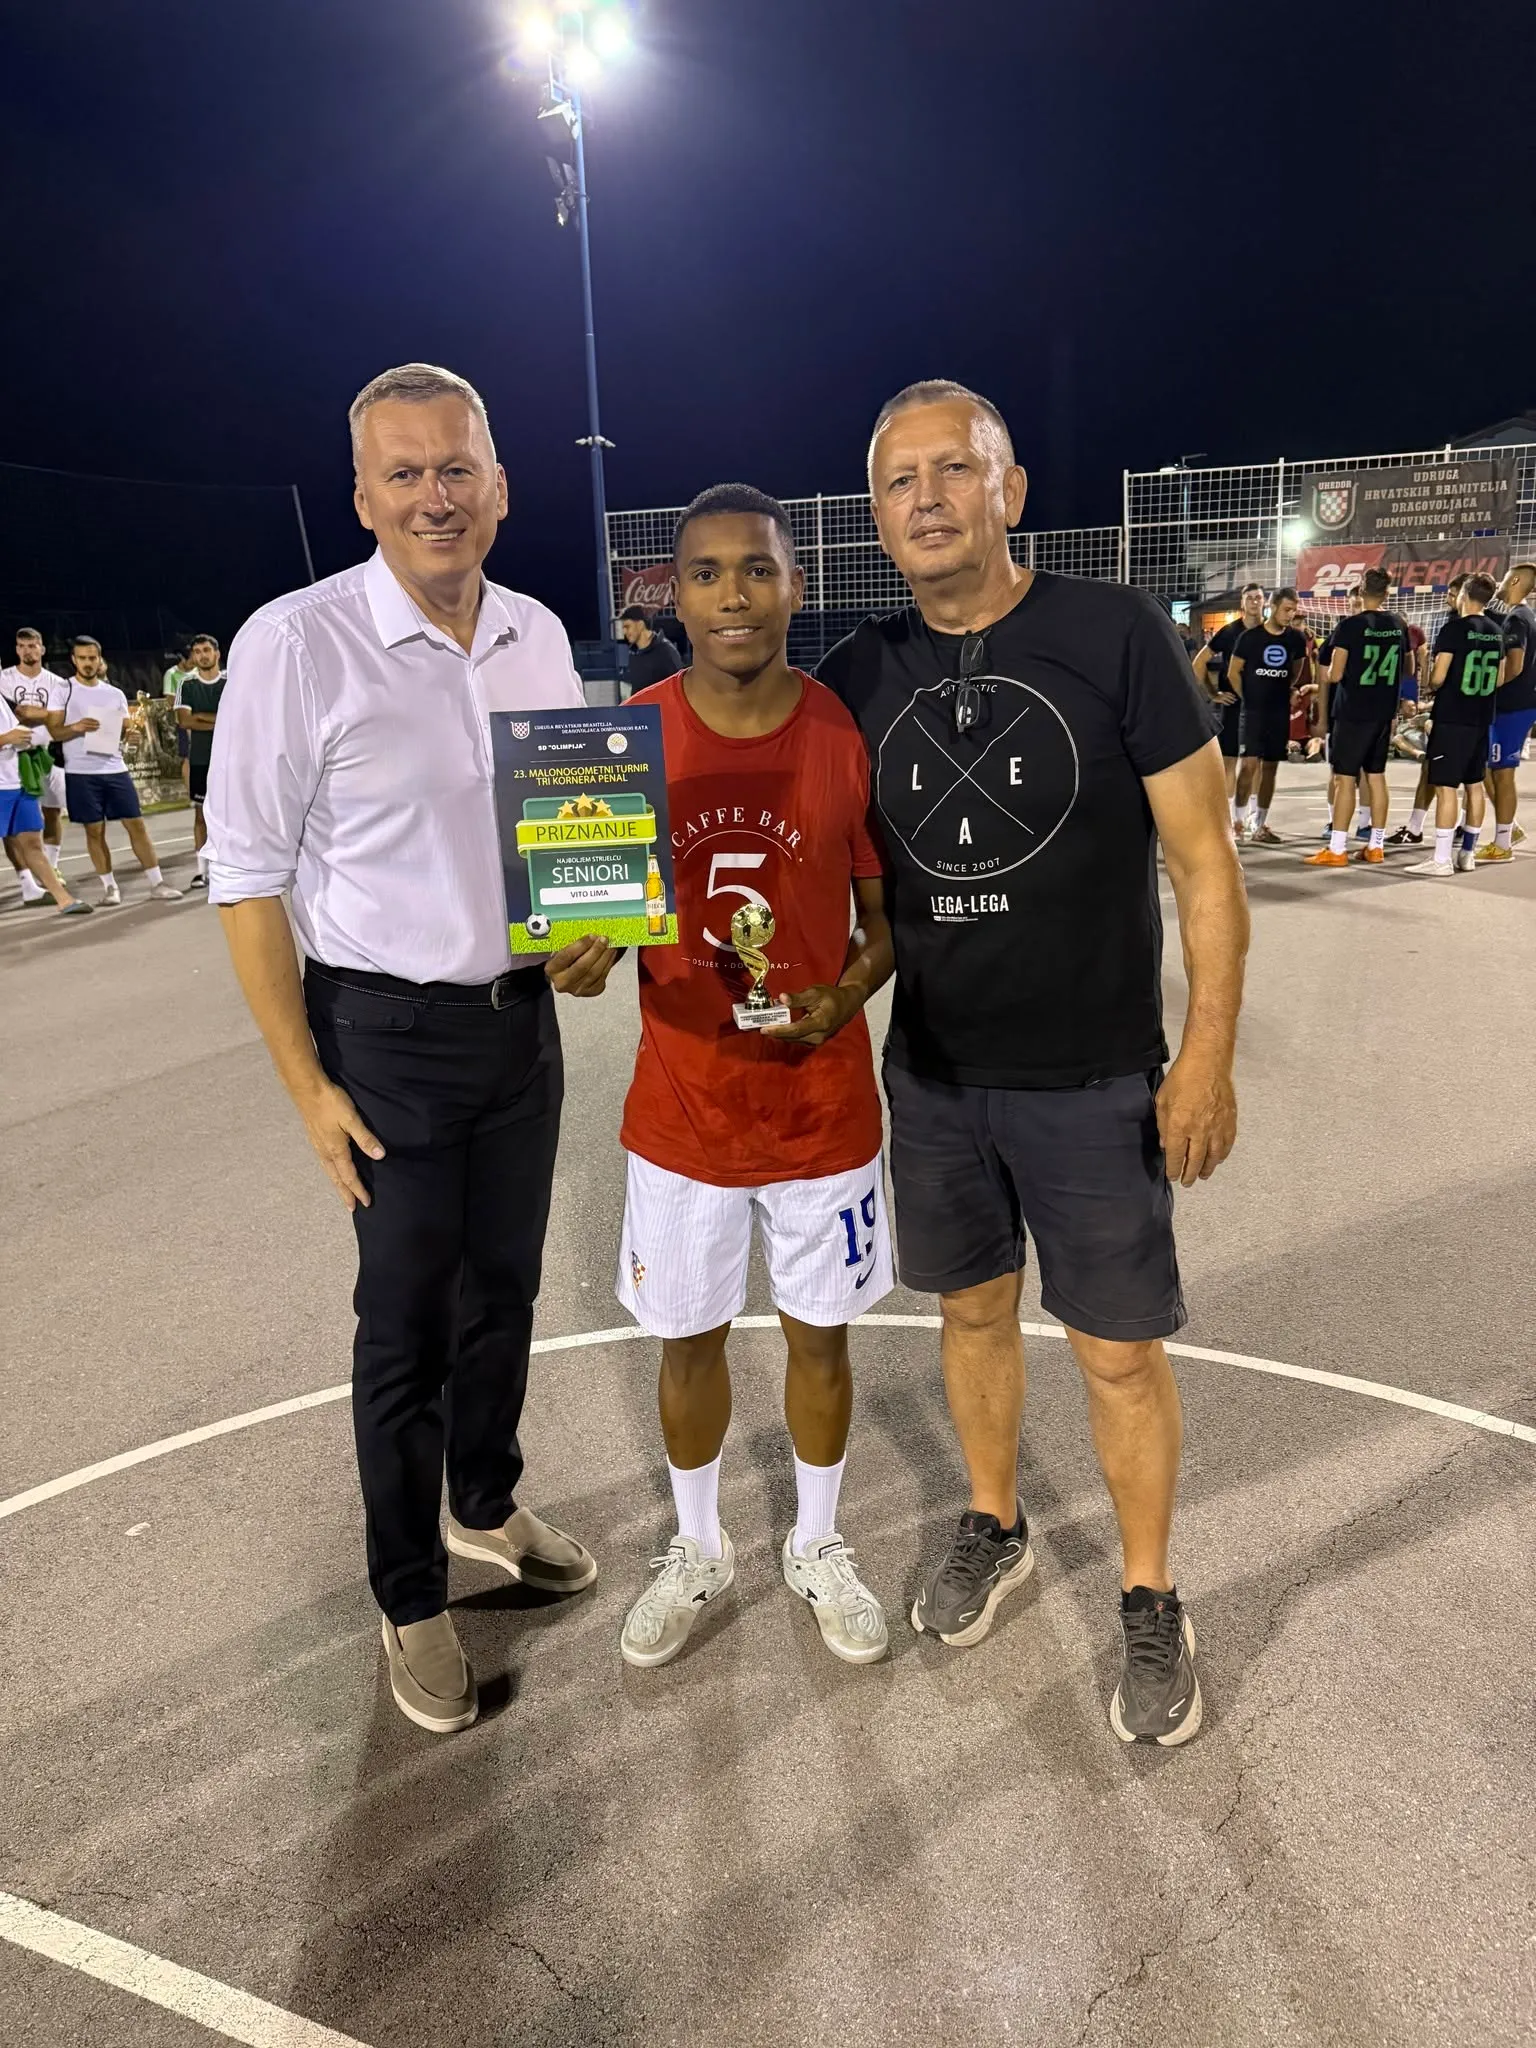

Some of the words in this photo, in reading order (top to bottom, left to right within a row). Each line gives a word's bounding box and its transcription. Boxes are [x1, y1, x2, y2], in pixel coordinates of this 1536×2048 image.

[1413, 469, 1459, 483] UDRUGA
[1364, 488, 1430, 500] HRVATSKIH
[1435, 480, 1508, 496] BRANITELJA
[1391, 498, 1478, 513] DRAGOVOLJACA
[1375, 515, 1455, 529] DOMOVINSKOG
[1459, 511, 1492, 523] RATA
[1310, 563, 1366, 592] 25
[1255, 668, 1288, 678] exoro
[1360, 644, 1400, 686] 24
[1461, 650, 1500, 697] 66
[940, 684, 998, 698] AUTTIC
[514, 769, 528, 779] 23.
[529, 765, 614, 778] MALONOGOMETNI
[616, 763, 649, 775] TURNIR
[536, 777, 551, 787] TRI
[553, 775, 597, 786] KORNERA
[599, 773, 628, 784] PENAL
[912, 764, 923, 791] L
[1009, 756, 1023, 786] E
[536, 821, 638, 842] PRIZNANJE
[671, 806, 745, 848] CAFFE
[758, 809, 801, 849] BAR
[958, 817, 973, 845] A
[551, 863, 629, 884] SENIORI
[936, 860, 967, 873] SINCE
[972, 857, 1000, 872] 2007
[589, 889, 609, 897] LIMA
[702, 853, 773, 952] 5
[930, 893, 1010, 914] LEGA-LEGA
[692, 958, 720, 968] OSIJEK
